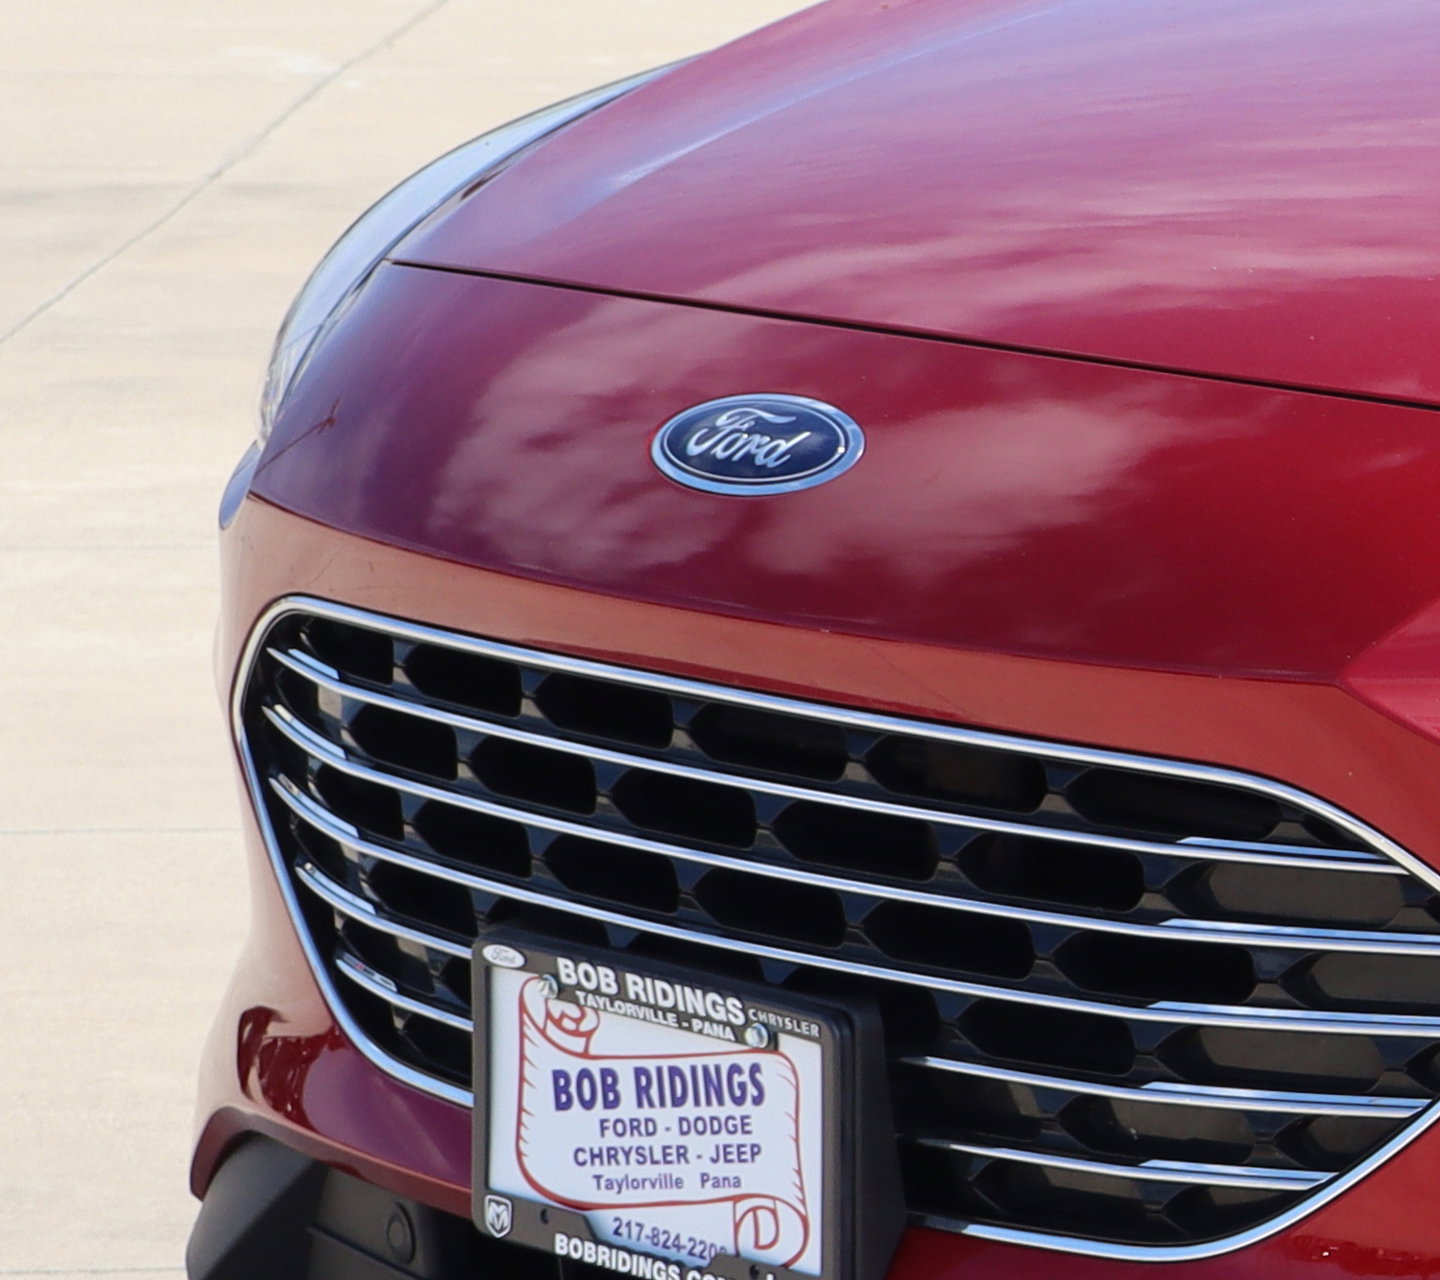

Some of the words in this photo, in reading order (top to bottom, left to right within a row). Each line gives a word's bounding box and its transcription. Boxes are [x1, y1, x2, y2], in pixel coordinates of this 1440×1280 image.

[686, 407, 812, 468] Ford
[557, 957, 619, 995] BOB
[625, 973, 746, 1026] RIDINGS
[575, 990, 679, 1028] TAYLORVILLE
[691, 1018, 736, 1042] PANA
[748, 1008, 820, 1038] CHRYSLER
[552, 1067, 622, 1111] BOB
[633, 1062, 766, 1109] RIDINGS
[599, 1118, 658, 1138] FORD
[678, 1114, 753, 1136] DODGE
[573, 1144, 690, 1167] CHRYSLER
[709, 1143, 762, 1164] JEEP
[593, 1173, 684, 1195] Taylorville
[700, 1172, 742, 1189] Pana
